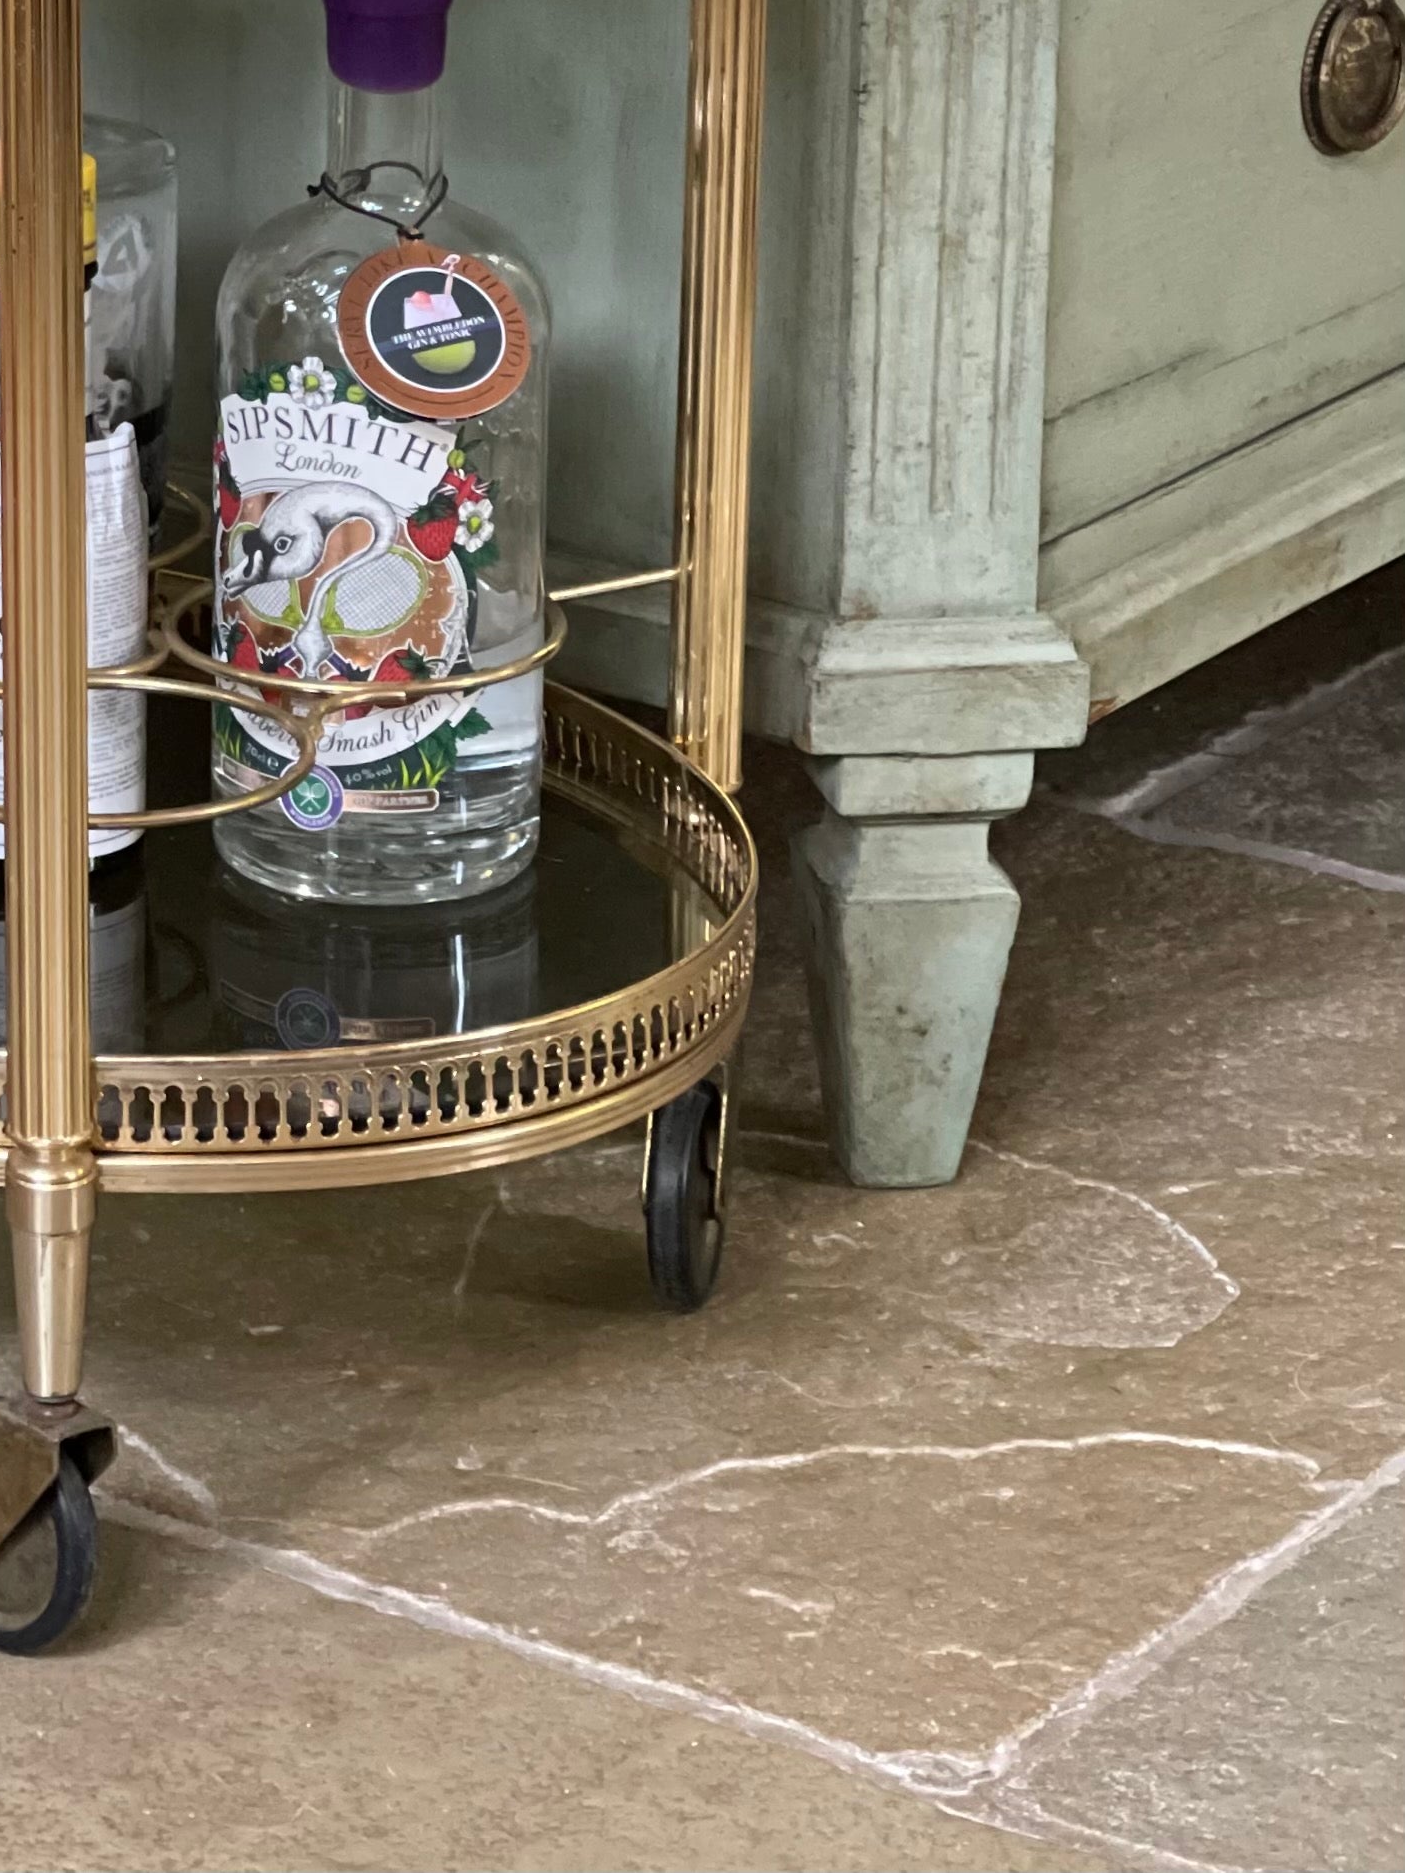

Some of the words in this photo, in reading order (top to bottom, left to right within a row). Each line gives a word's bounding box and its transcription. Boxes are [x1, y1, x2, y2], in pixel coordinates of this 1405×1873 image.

[415, 316, 486, 339] WIMBLEDON
[225, 405, 440, 474] SIPSMITH
[275, 441, 363, 480] London
[316, 720, 393, 753] Smash
[391, 692, 442, 738] Gin
